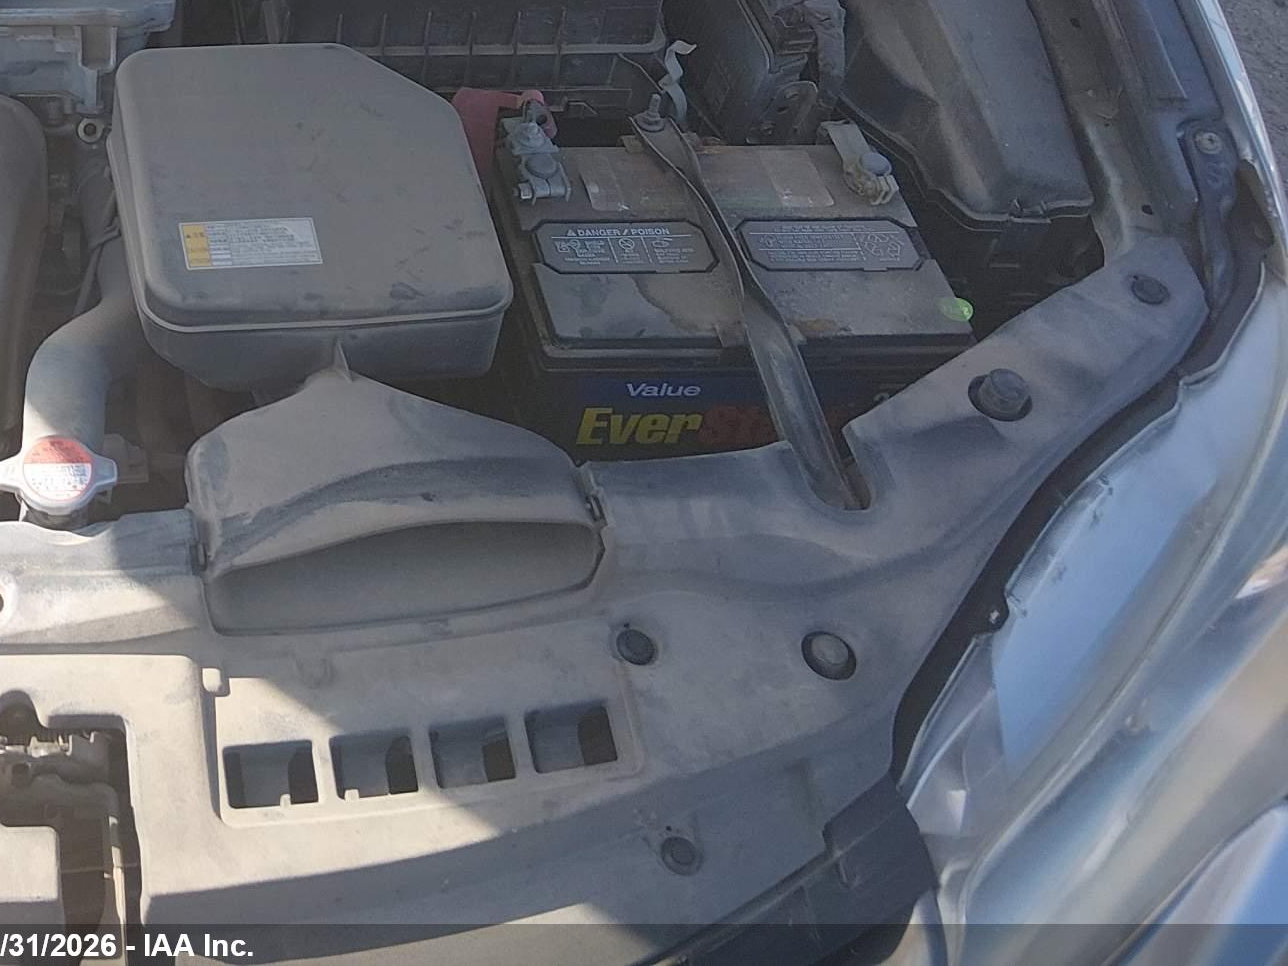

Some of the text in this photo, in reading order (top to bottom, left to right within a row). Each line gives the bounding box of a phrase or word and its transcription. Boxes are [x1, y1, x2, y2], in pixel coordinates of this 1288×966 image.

[578, 228, 621, 237] DANGER
[631, 227, 671, 236] POISON
[625, 382, 702, 397] Value
